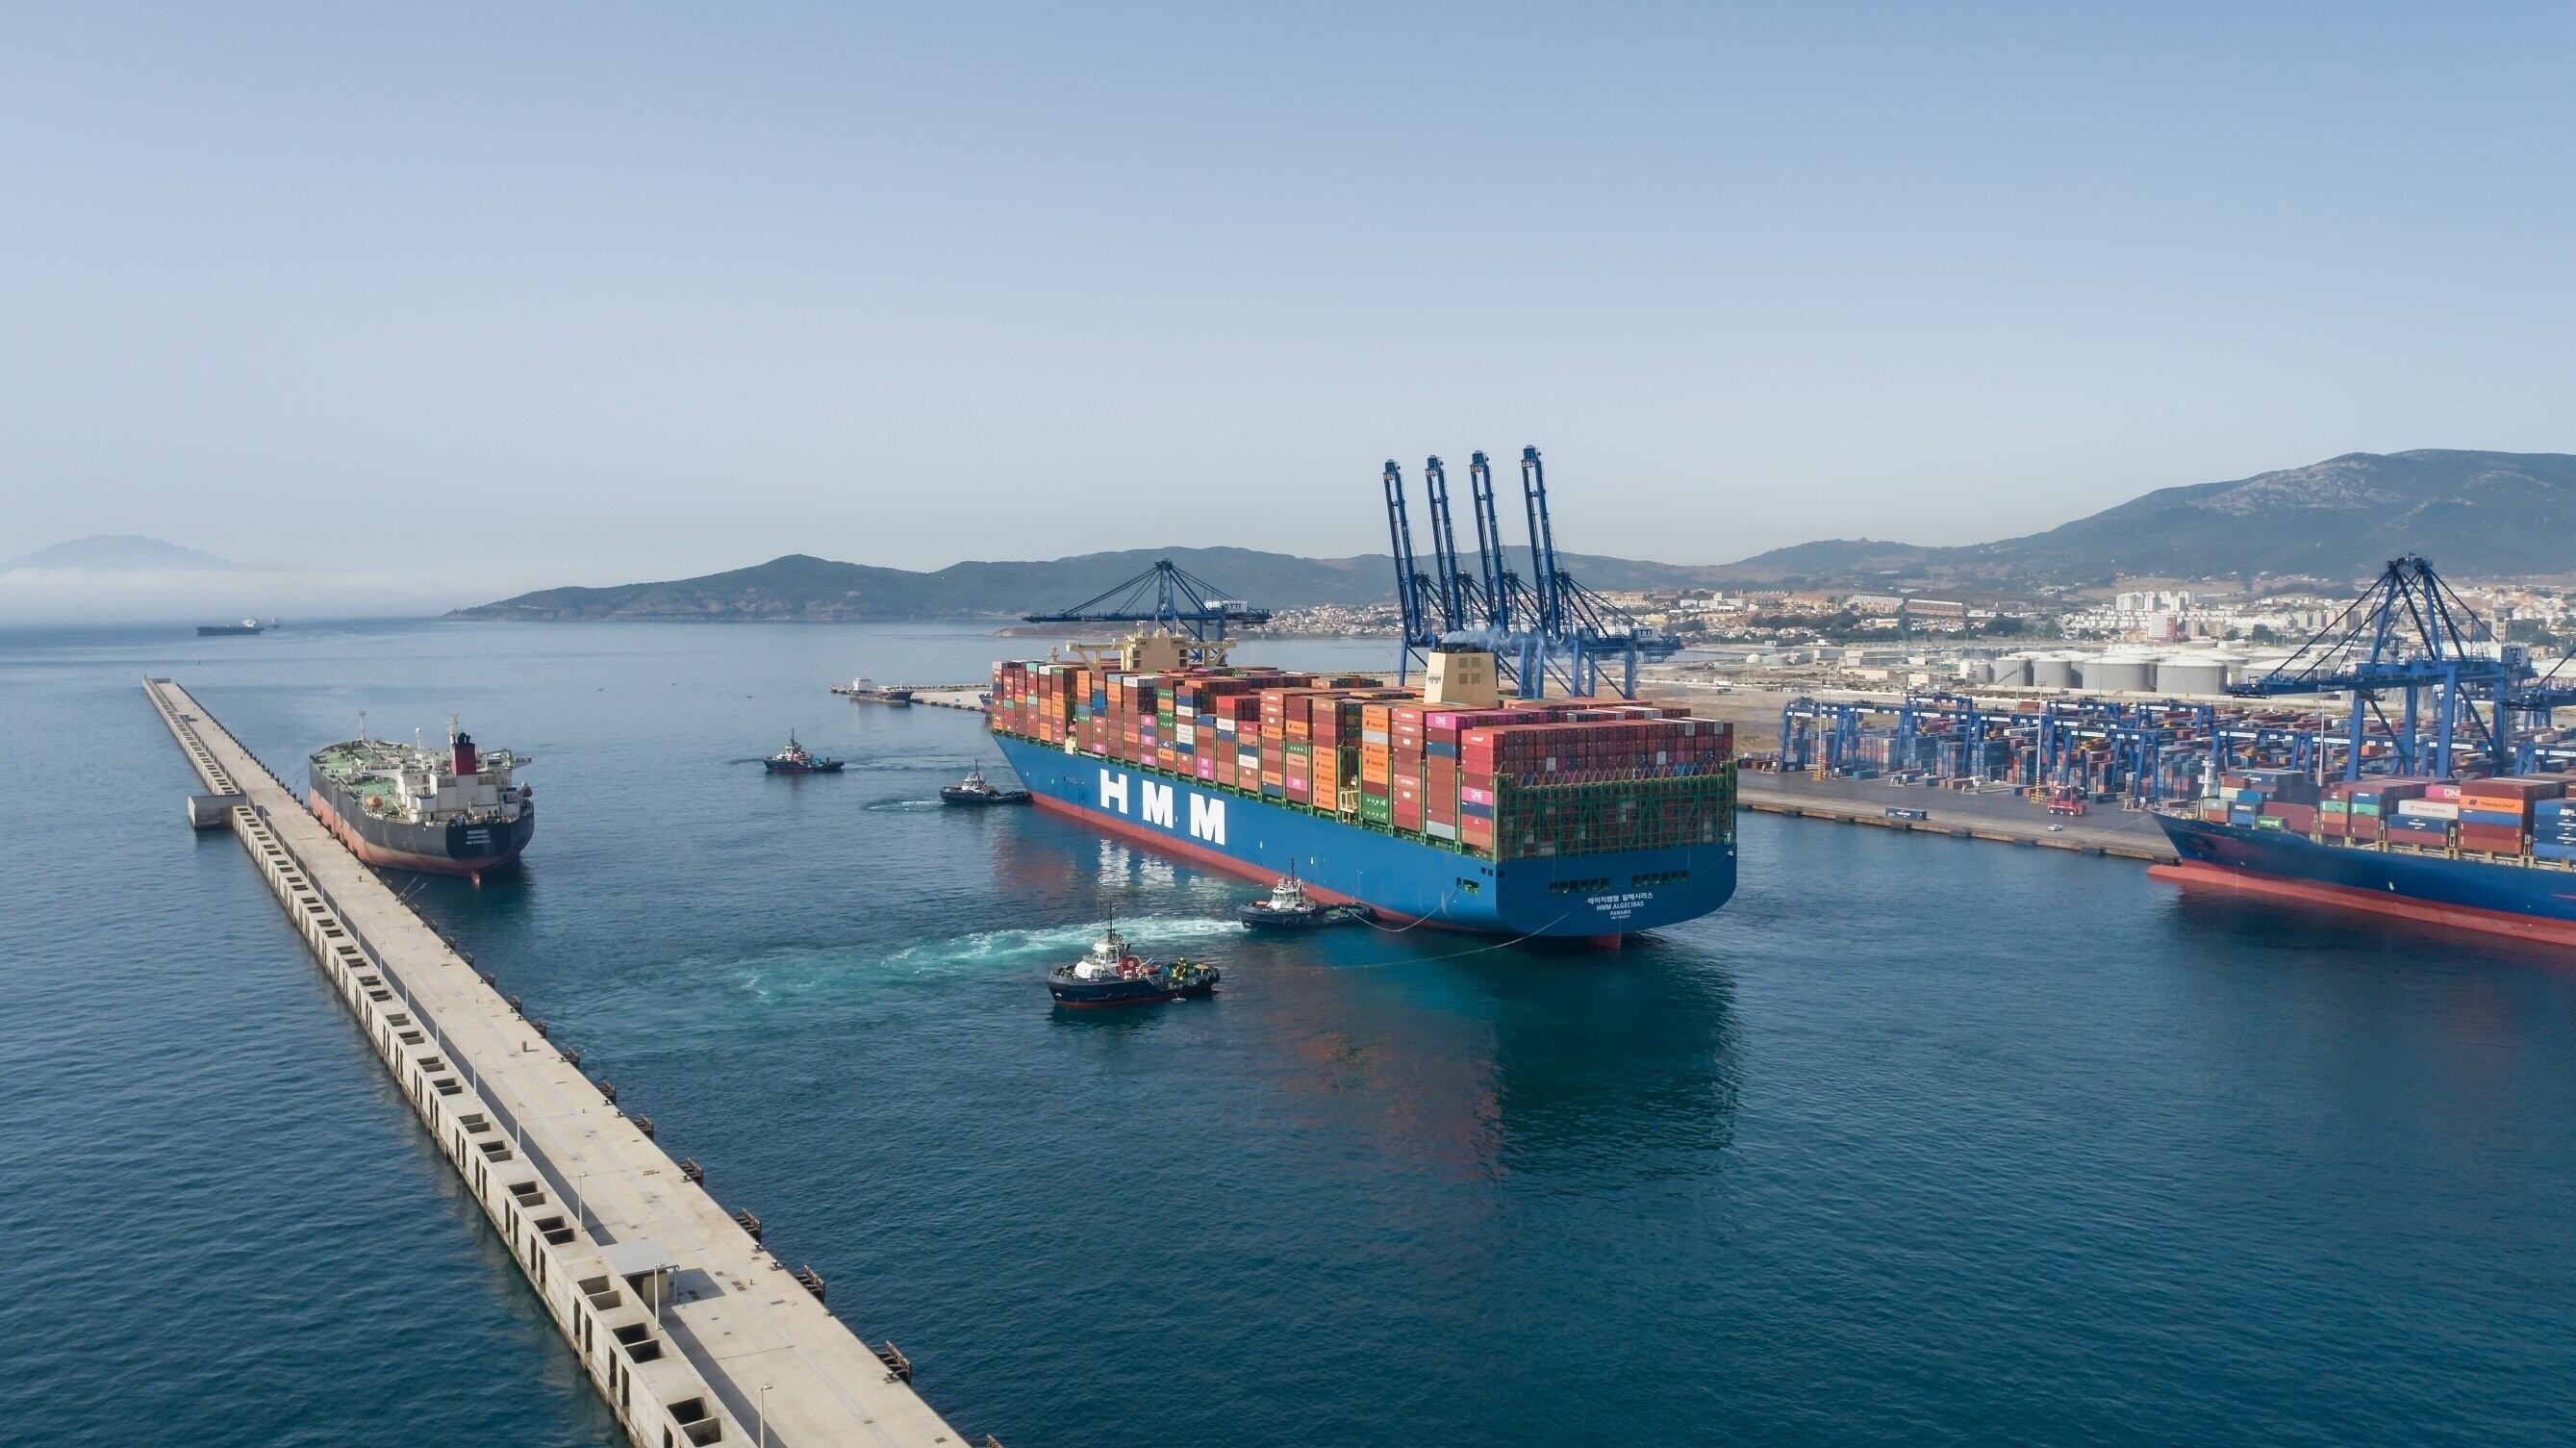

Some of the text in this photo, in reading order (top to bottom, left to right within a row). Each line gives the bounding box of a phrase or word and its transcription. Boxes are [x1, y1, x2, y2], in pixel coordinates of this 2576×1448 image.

[1427, 675, 1442, 685] HMM
[1099, 768, 1225, 846] HMM
[1612, 901, 1644, 910] ALGECIRAS
